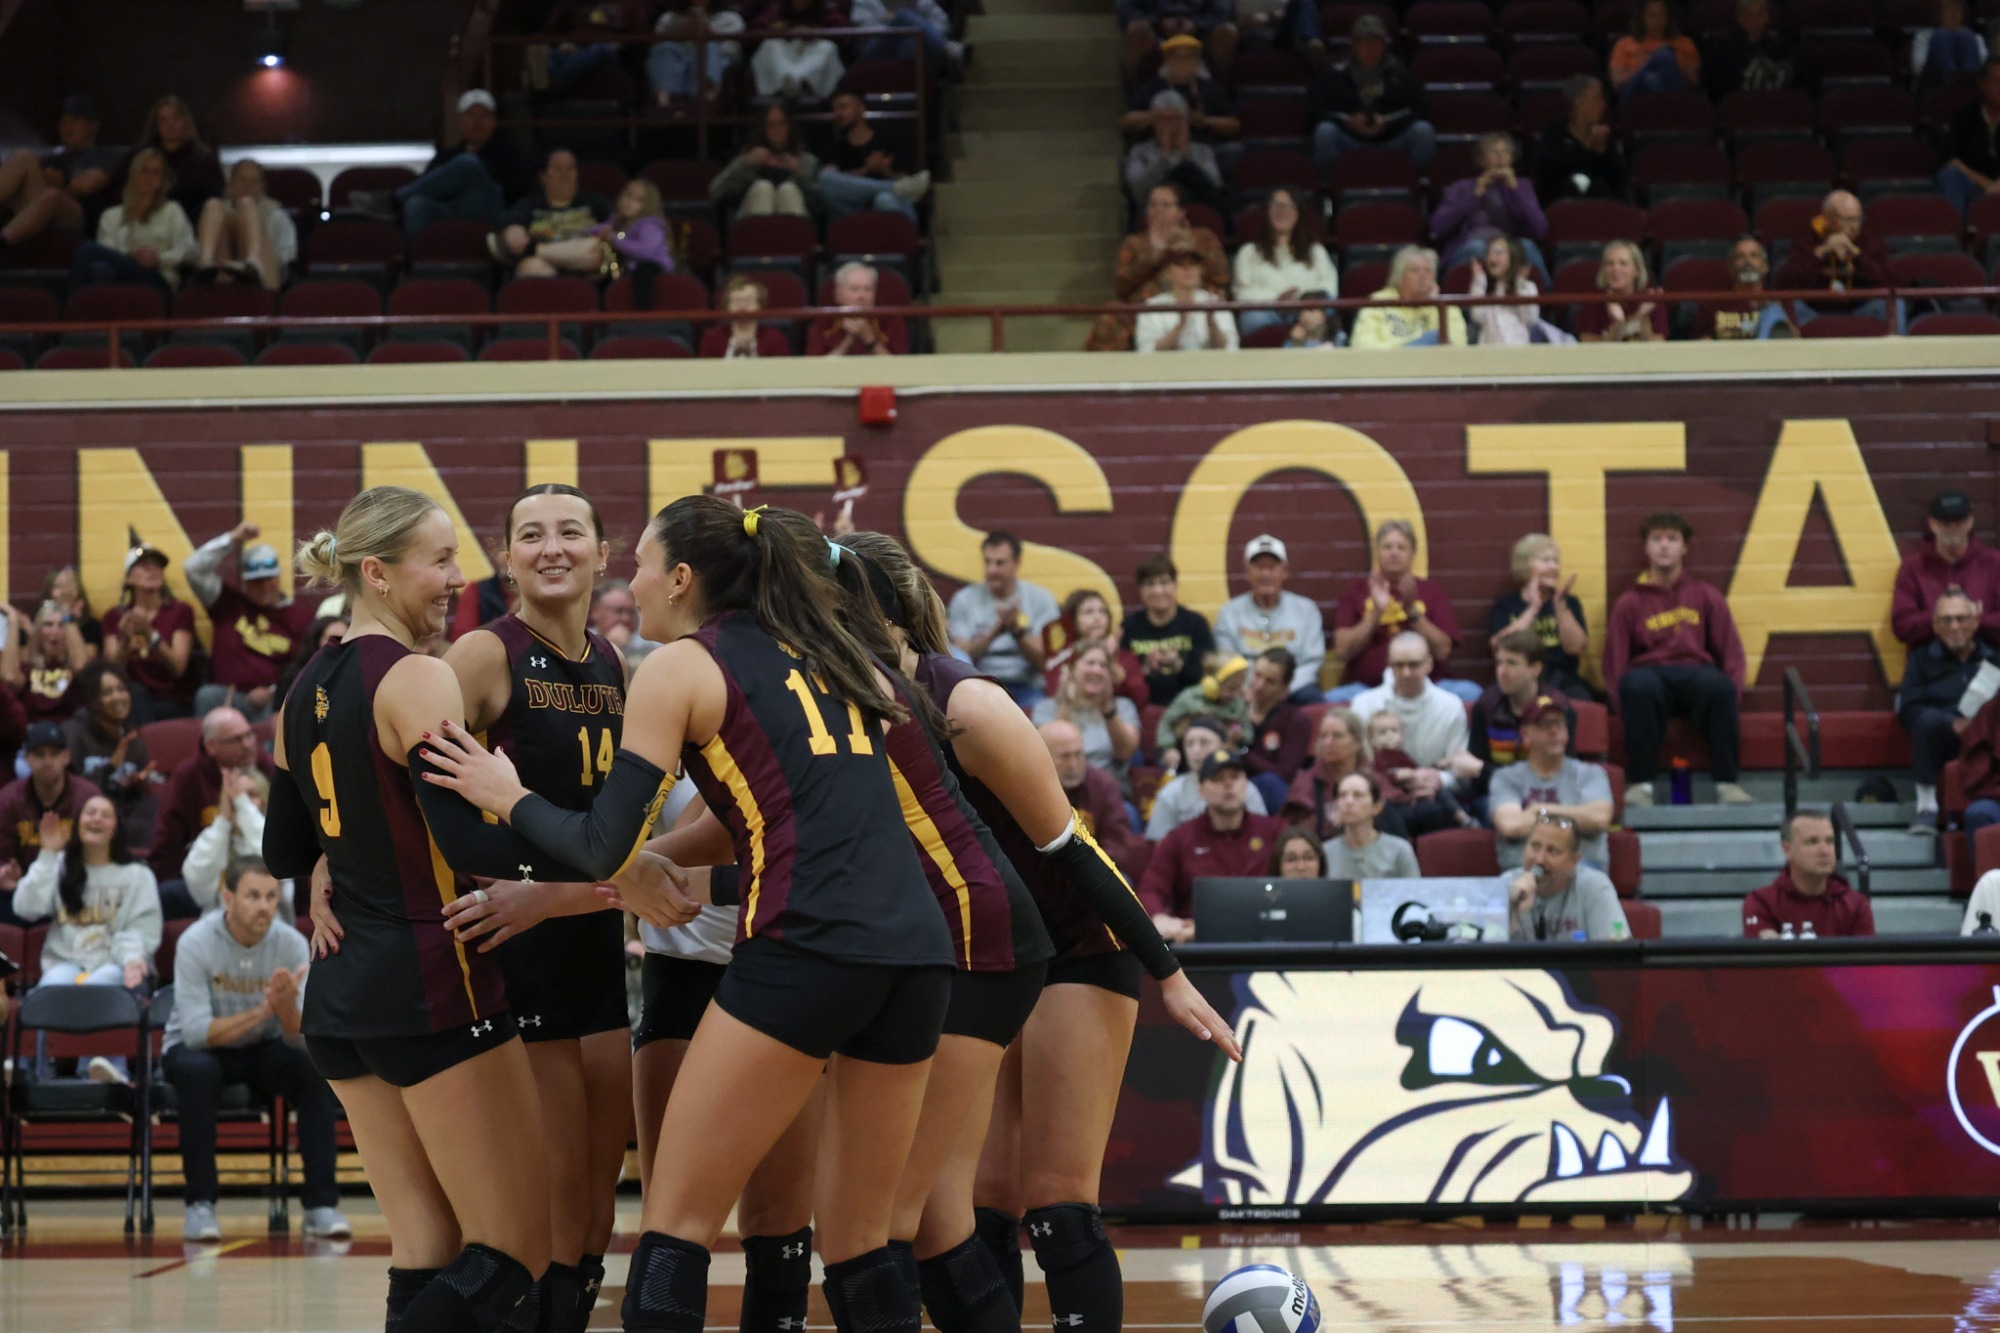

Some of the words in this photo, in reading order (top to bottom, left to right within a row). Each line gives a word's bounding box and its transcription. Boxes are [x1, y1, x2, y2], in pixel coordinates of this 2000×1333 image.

[0, 418, 1908, 689] NSOTA
[310, 741, 342, 837] 9
[577, 726, 614, 786] 14
